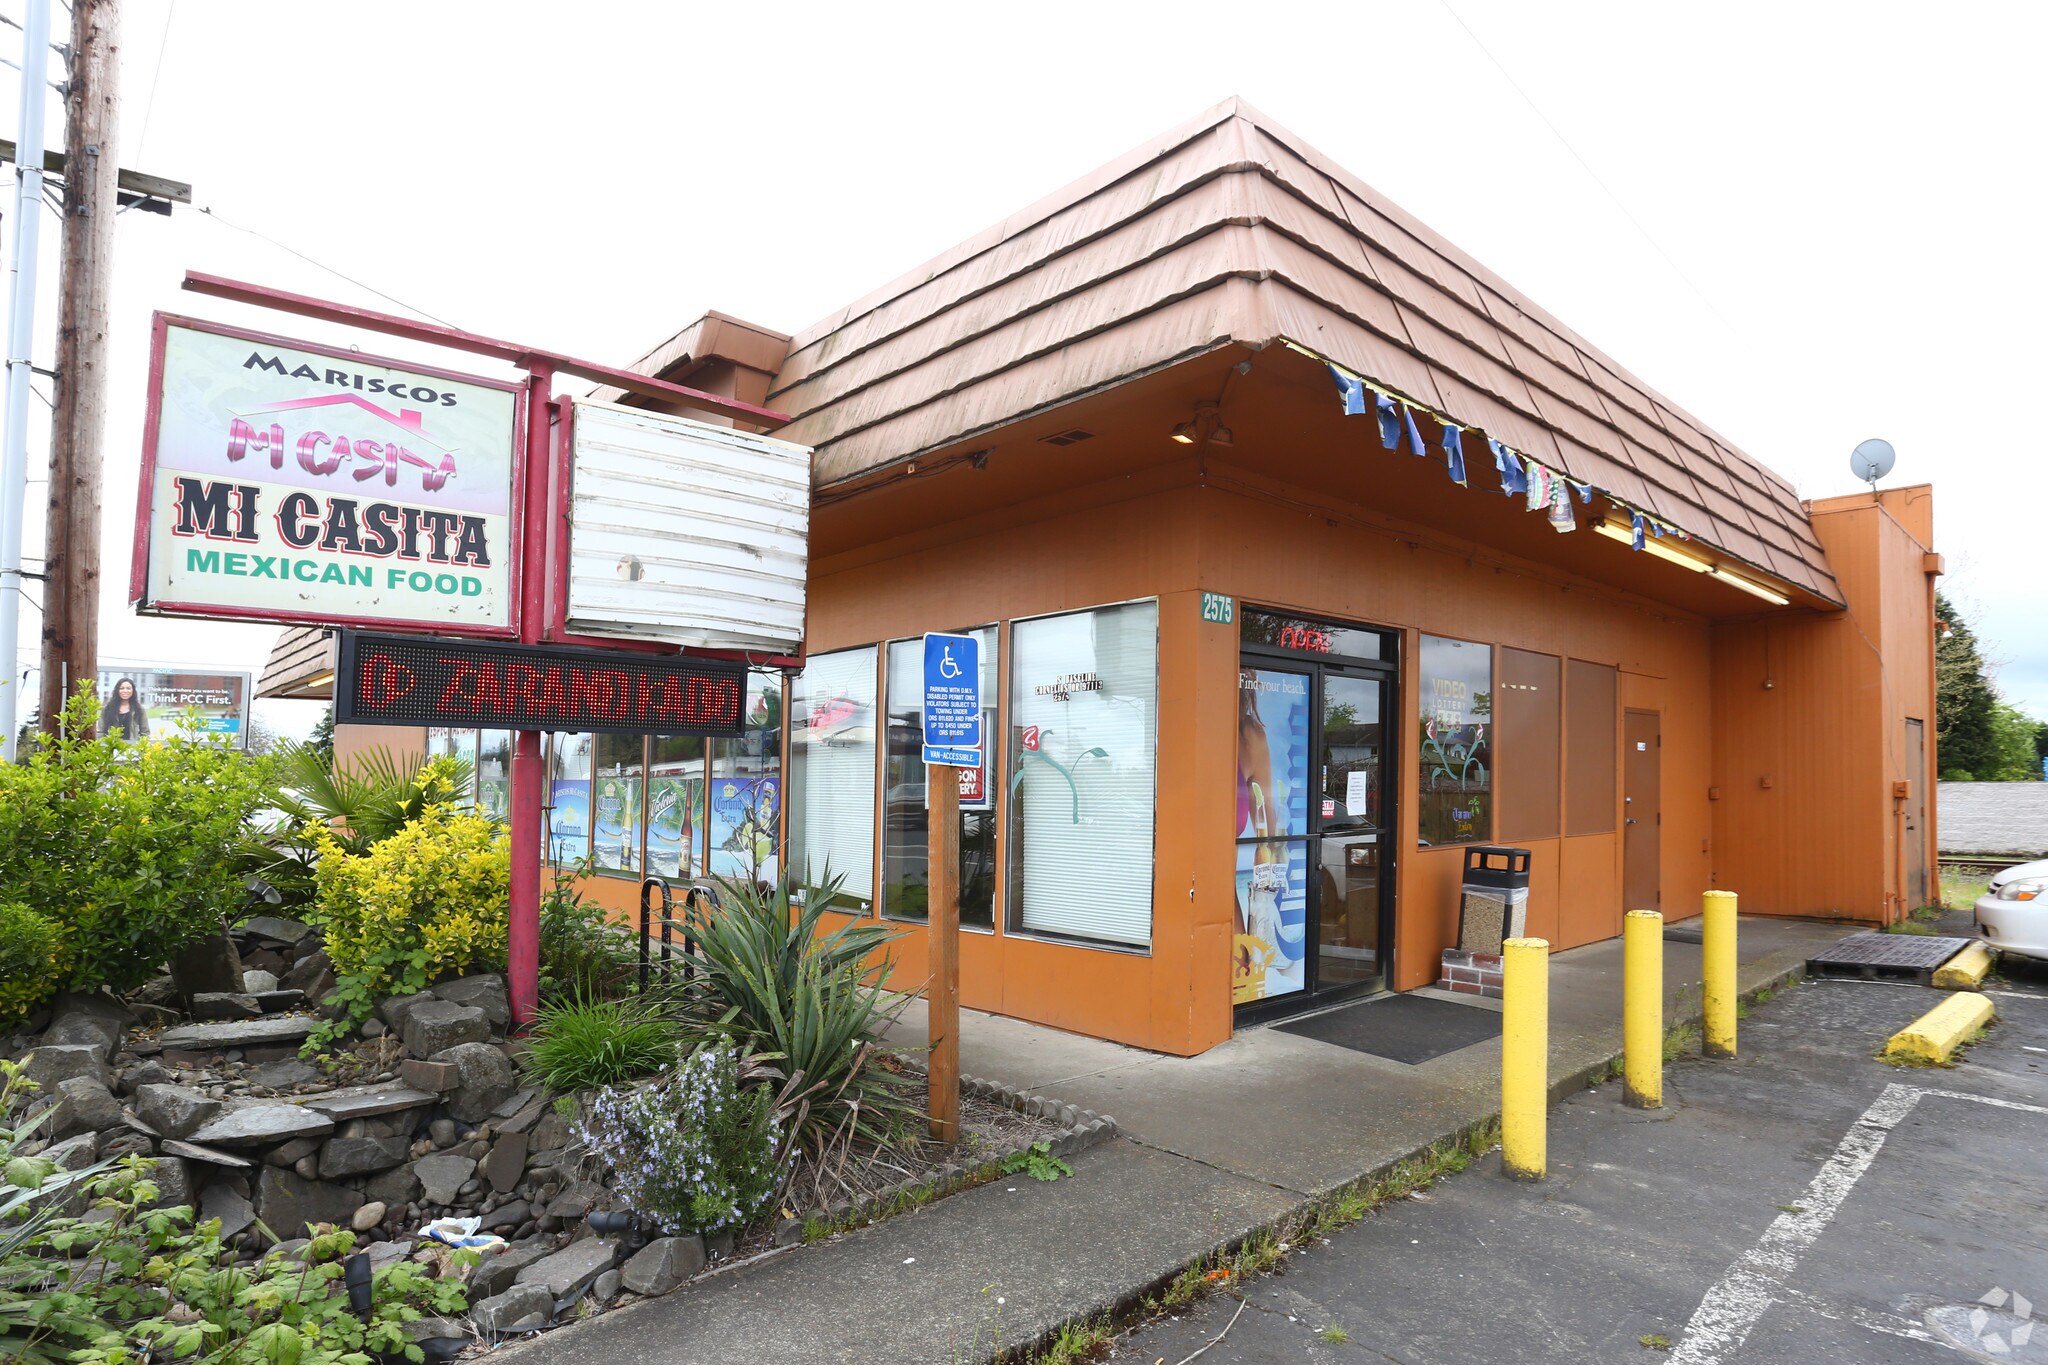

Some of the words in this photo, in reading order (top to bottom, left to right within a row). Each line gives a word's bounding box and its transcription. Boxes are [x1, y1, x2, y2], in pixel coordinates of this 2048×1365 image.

[242, 351, 458, 407] MARISCOS
[227, 417, 284, 470] MI
[296, 430, 458, 493] CASITA
[172, 476, 262, 543] MI
[274, 492, 492, 568] CASITA
[186, 548, 373, 587] MEXICAN
[387, 568, 483, 597] FOOD
[1203, 593, 1233, 623] 2575
[1065, 672, 1097, 684] BASELINE
[1082, 680, 1104, 692] 97113
[1238, 672, 1259, 690] Find
[1260, 681, 1281, 697] your
[1282, 678, 1307, 695] beach.
[1431, 677, 1466, 699] VIDEO
[148, 693, 177, 703] Think
[180, 694, 204, 704] PCC
[205, 694, 232, 705] First.
[1432, 698, 1467, 711] LOTTERY
[929, 750, 974, 762] VAN-ACCESSIBLE
[597, 794, 621, 813] Corona
[714, 796, 742, 813] Corona
[1322, 801, 1334, 809] ATM
[720, 812, 737, 823] Extra
[556, 820, 581, 840] Corona
[561, 838, 577, 853] Extra
